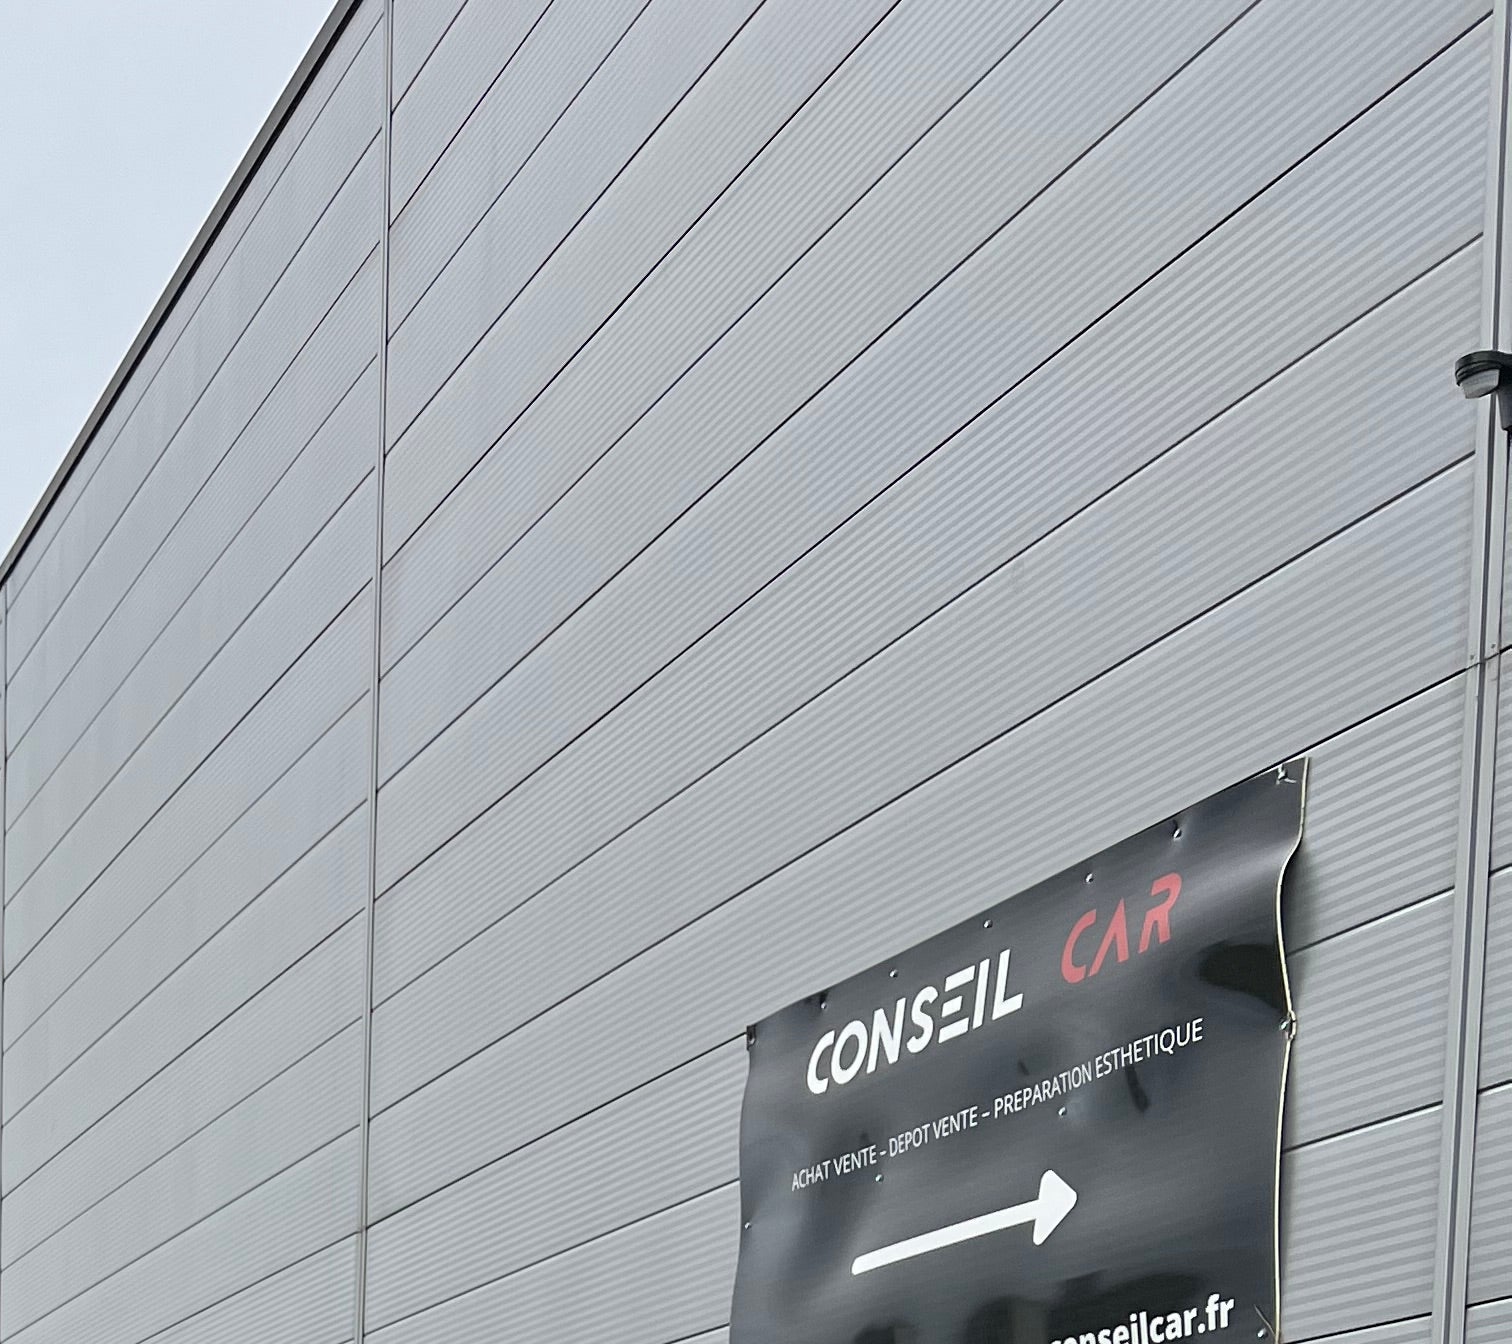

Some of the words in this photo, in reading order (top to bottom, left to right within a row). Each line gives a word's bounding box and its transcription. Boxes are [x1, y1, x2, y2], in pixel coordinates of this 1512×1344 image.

[806, 948, 1024, 1094] CONSEIL
[1060, 872, 1183, 984] CAR
[791, 1160, 830, 1191] ACHAT
[832, 1144, 877, 1176] VENTE
[889, 1123, 931, 1157] DEPOT
[932, 1106, 978, 1139] VENTE
[993, 1061, 1092, 1119] PREPARATION
[1095, 1017, 1204, 1079] ESTHETIQUE
